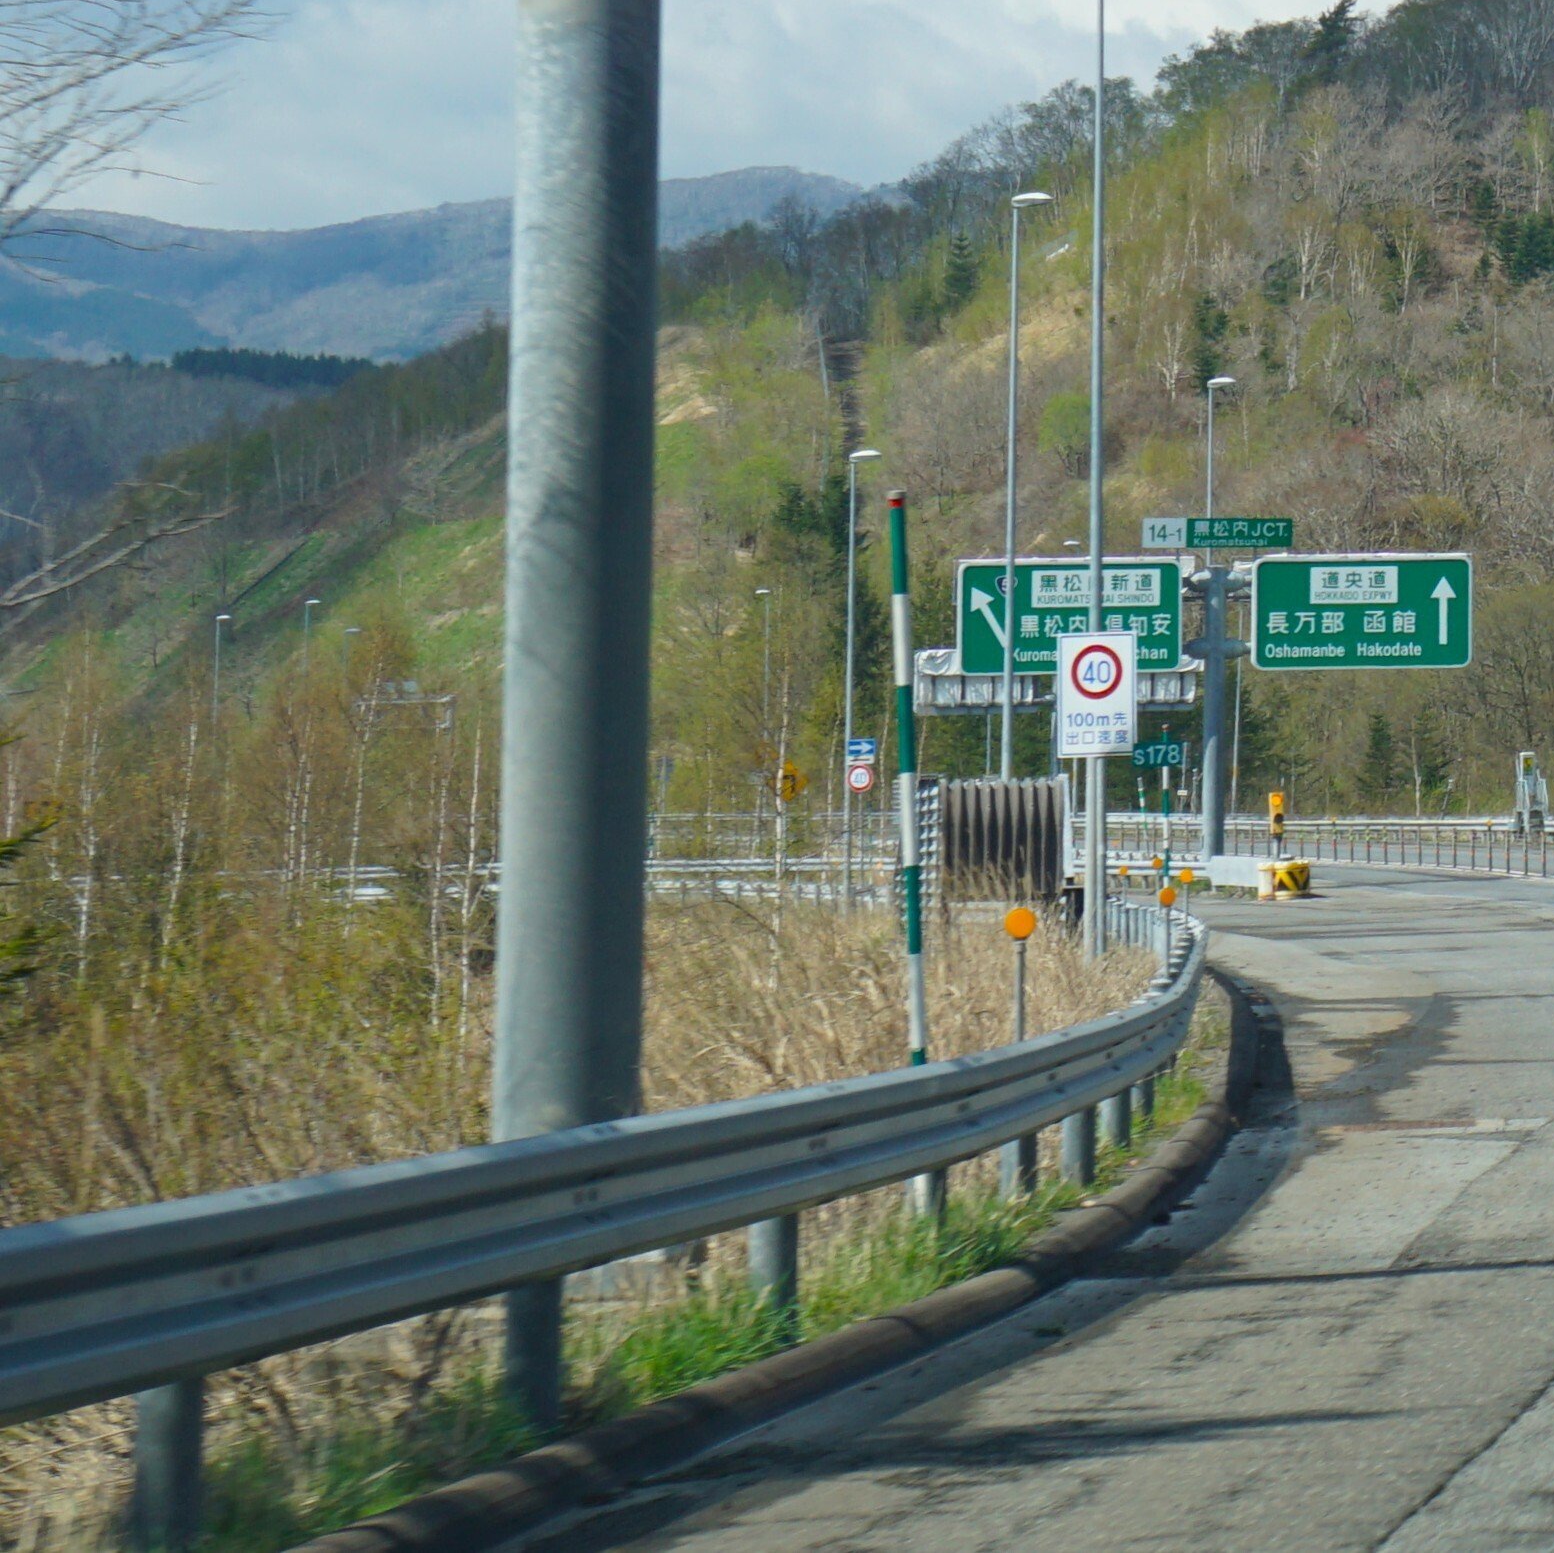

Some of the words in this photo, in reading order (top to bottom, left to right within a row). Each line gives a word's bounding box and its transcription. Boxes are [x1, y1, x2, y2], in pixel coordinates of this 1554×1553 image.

[1148, 524, 1182, 543] 14-1
[1192, 537, 1268, 547] Kuromatsunai
[1038, 573, 1155, 593] 黒松新道
[1321, 570, 1387, 589] 道央道
[1037, 593, 1116, 605] KUROMATSAI
[1118, 593, 1154, 604] SHINDO
[1314, 591, 1359, 601] HOKKAIDO
[1362, 590, 1393, 601] EXPWY
[1020, 614, 1087, 639] 黒松内
[1266, 611, 1345, 635] 長万部
[1363, 610, 1417, 634] 函館
[1264, 643, 1346, 659] Oshamanbe
[1356, 641, 1423, 657] Hakodate
[1082, 660, 1112, 685] 40
